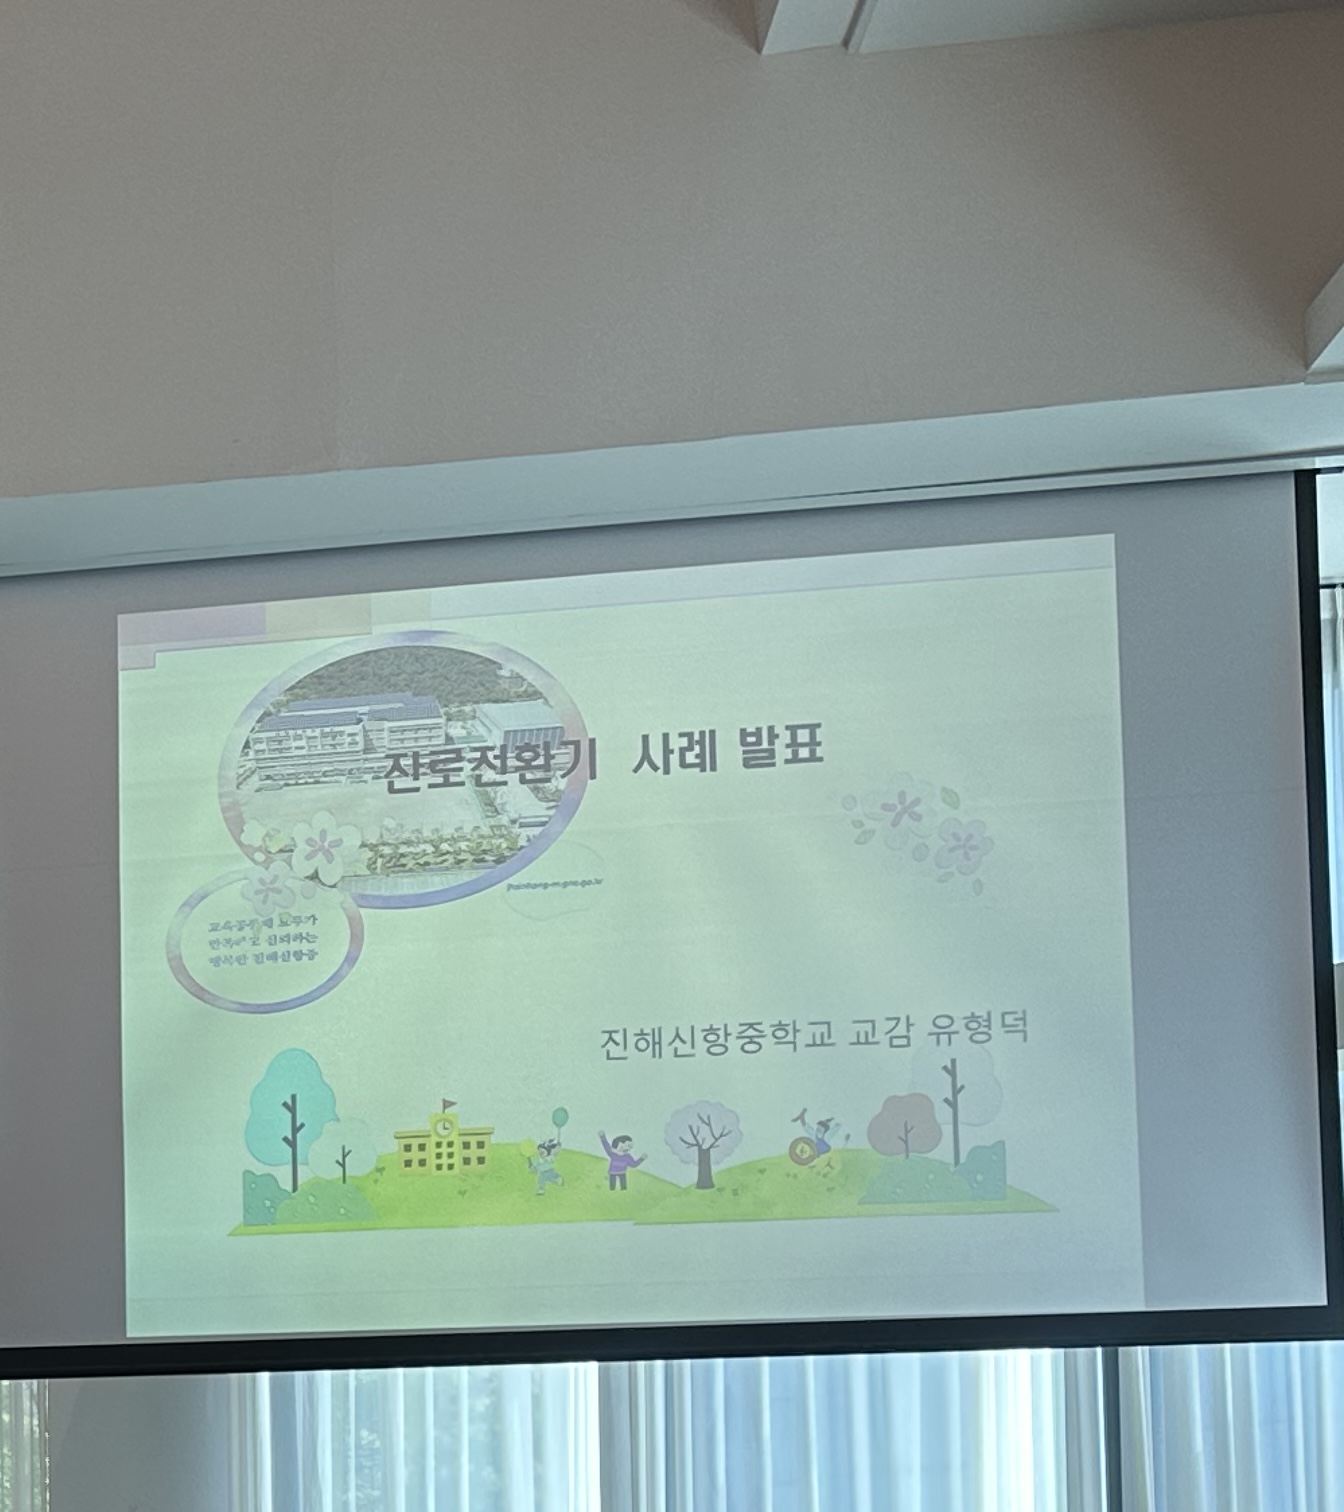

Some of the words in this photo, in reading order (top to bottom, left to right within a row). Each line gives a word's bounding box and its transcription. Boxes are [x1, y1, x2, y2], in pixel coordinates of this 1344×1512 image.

[383, 737, 598, 795] 진로전환기
[632, 728, 718, 776] 사례
[739, 721, 825, 770] 발표
[600, 1019, 837, 1062] 진해신항중학교
[848, 1014, 916, 1050] 교감
[927, 1008, 1028, 1047] 유형덕
